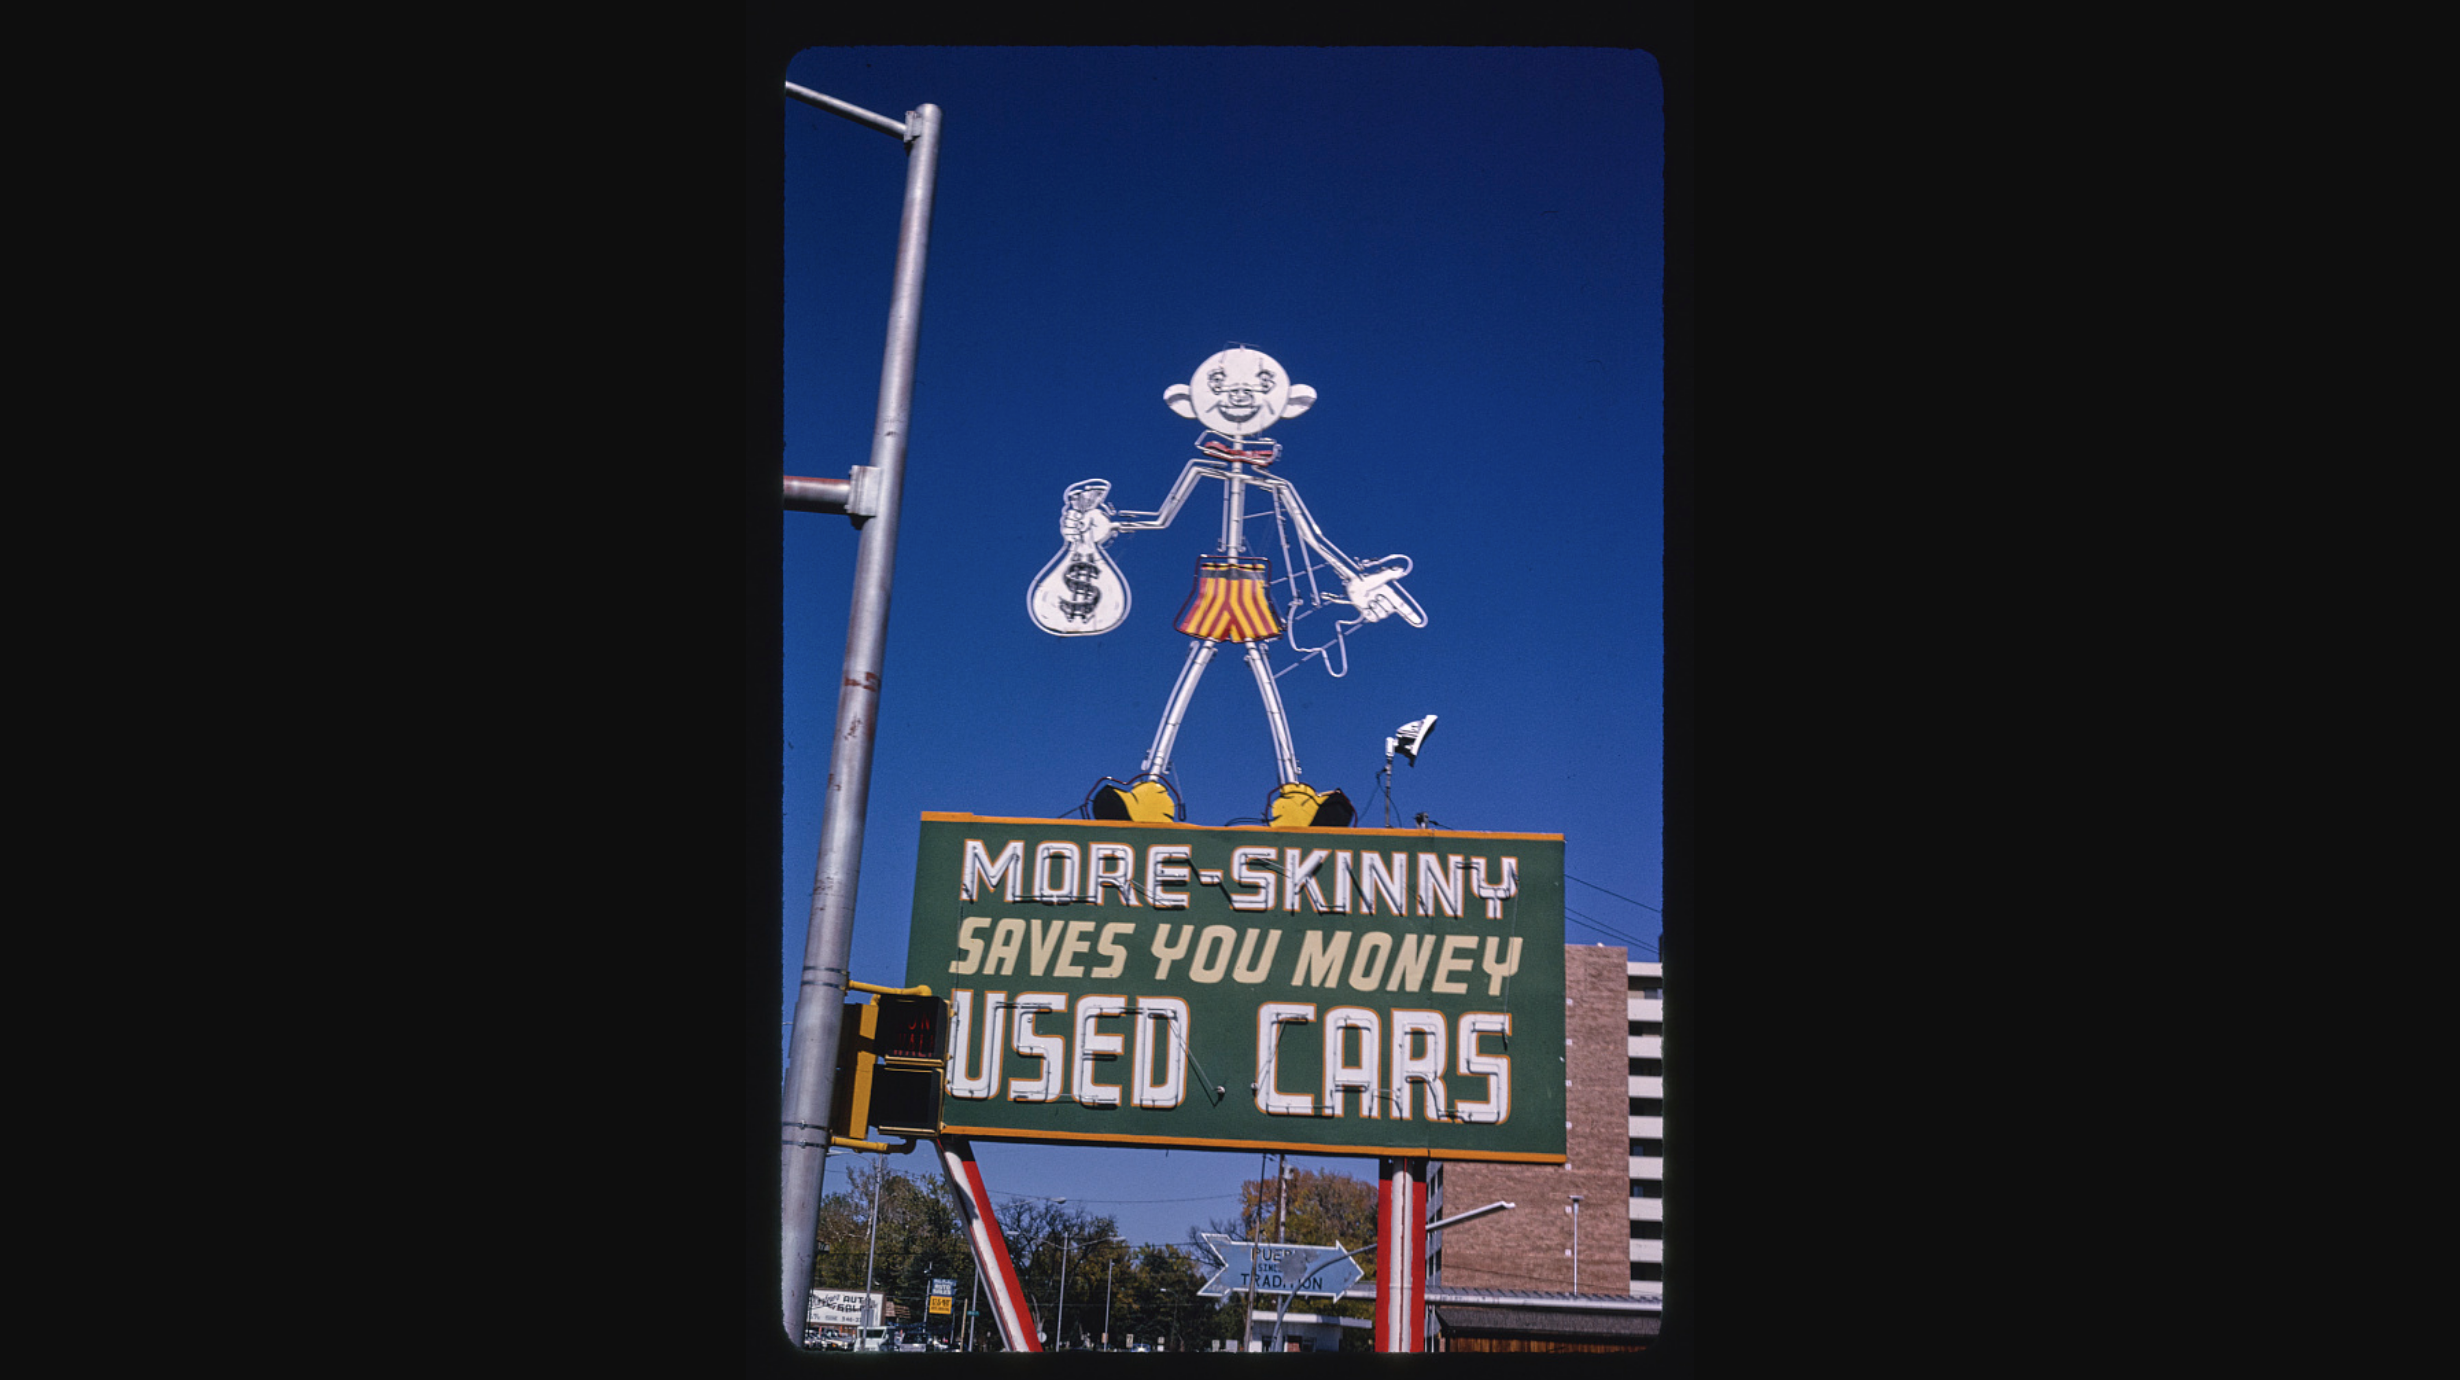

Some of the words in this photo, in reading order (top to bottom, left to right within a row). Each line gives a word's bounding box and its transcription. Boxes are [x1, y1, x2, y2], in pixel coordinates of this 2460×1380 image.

[961, 838, 1518, 919] MORE-SKINNY
[949, 917, 1135, 978] SAVES
[1150, 924, 1281, 984] YOU
[1291, 930, 1523, 996] MONEY
[945, 988, 1190, 1108] USED
[1255, 1002, 1512, 1125] CARS
[1241, 1273, 1323, 1290] TRADON
[1258, 1263, 1283, 1273] SINC
